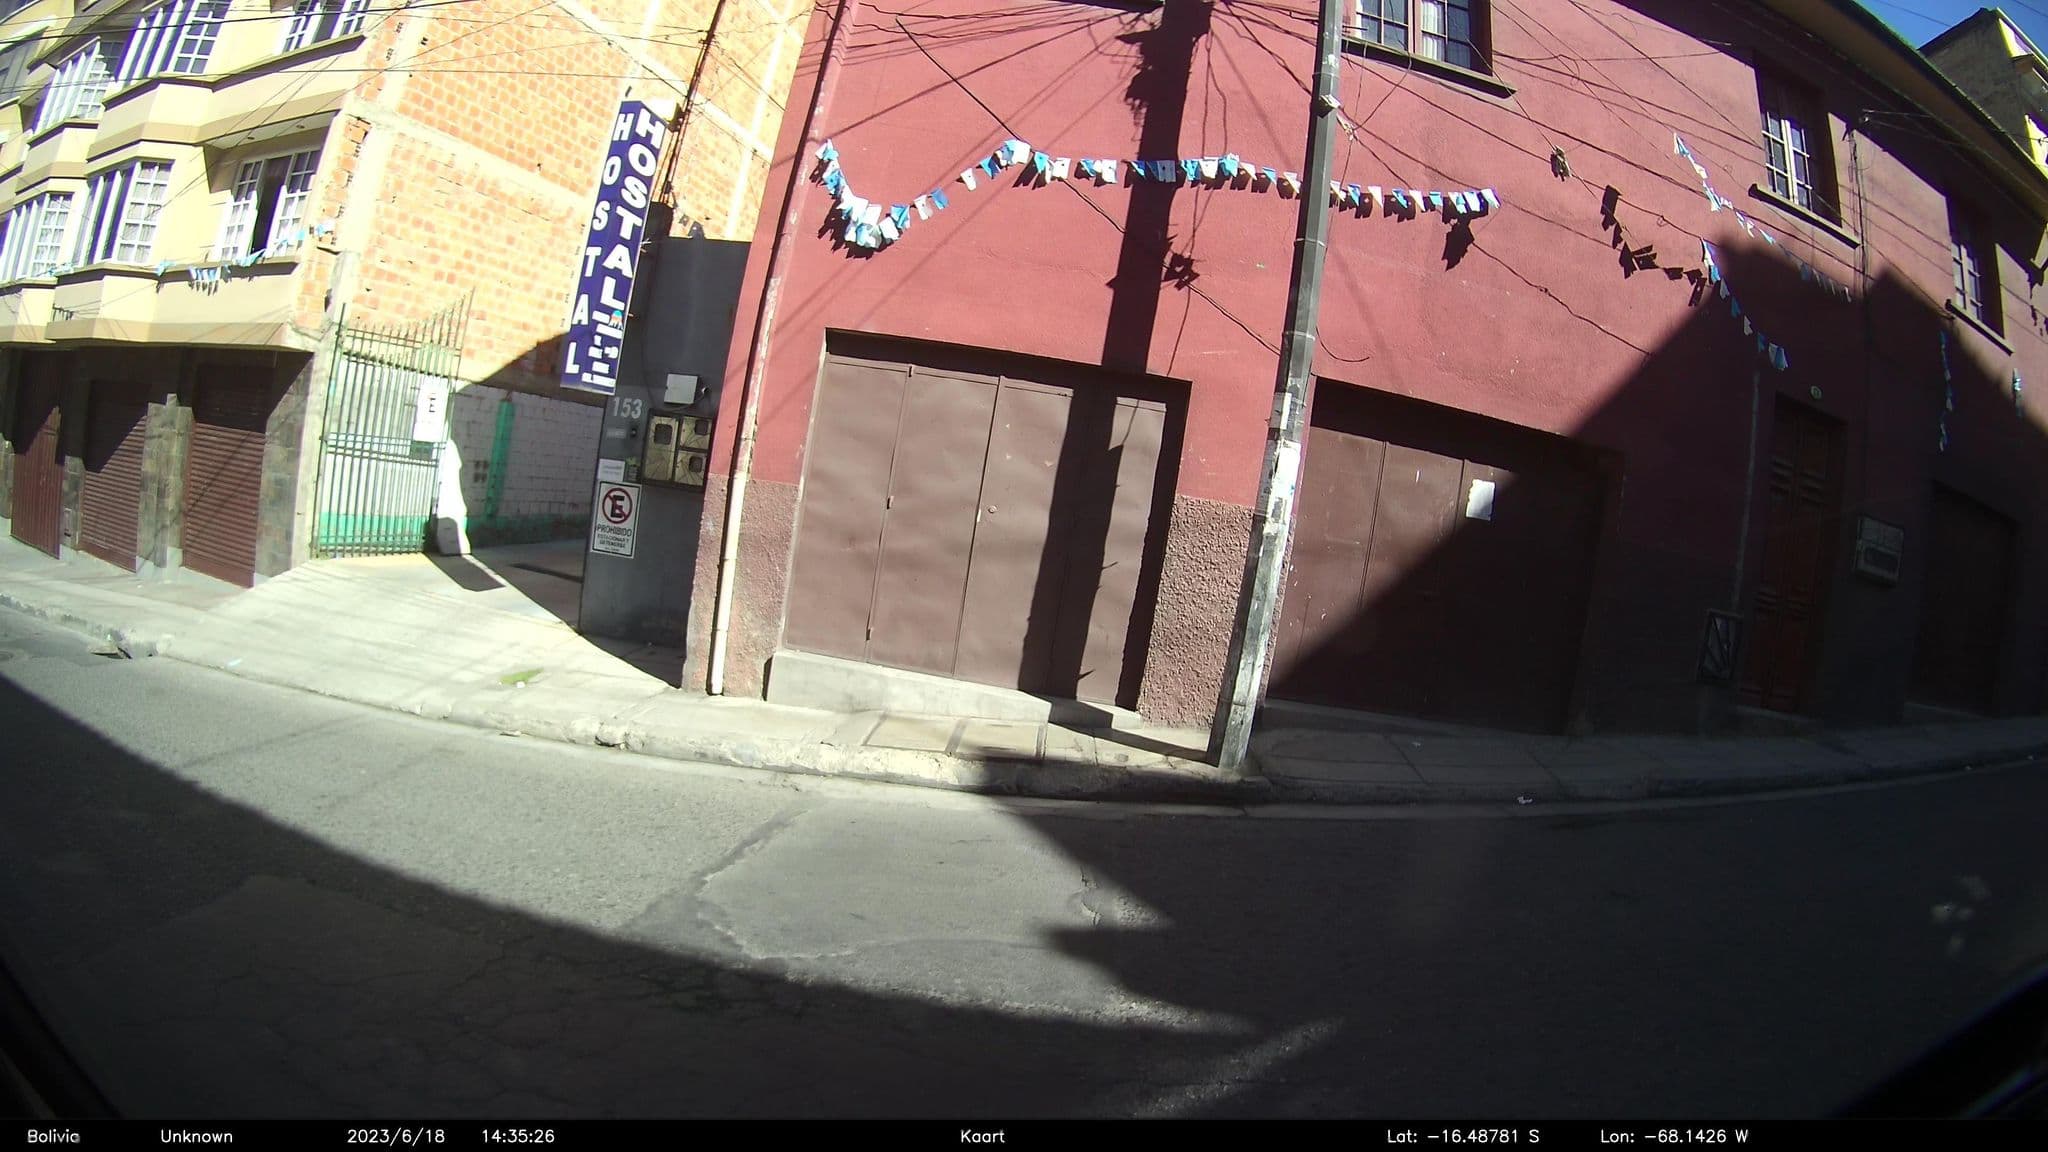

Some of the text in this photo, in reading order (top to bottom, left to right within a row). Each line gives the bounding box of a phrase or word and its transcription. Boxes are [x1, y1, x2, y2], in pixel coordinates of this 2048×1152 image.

[565, 113, 635, 374] HOSTAL
[600, 108, 666, 310] HOSTAL
[612, 397, 642, 419] 153
[597, 523, 632, 537] PROHIBIDO
